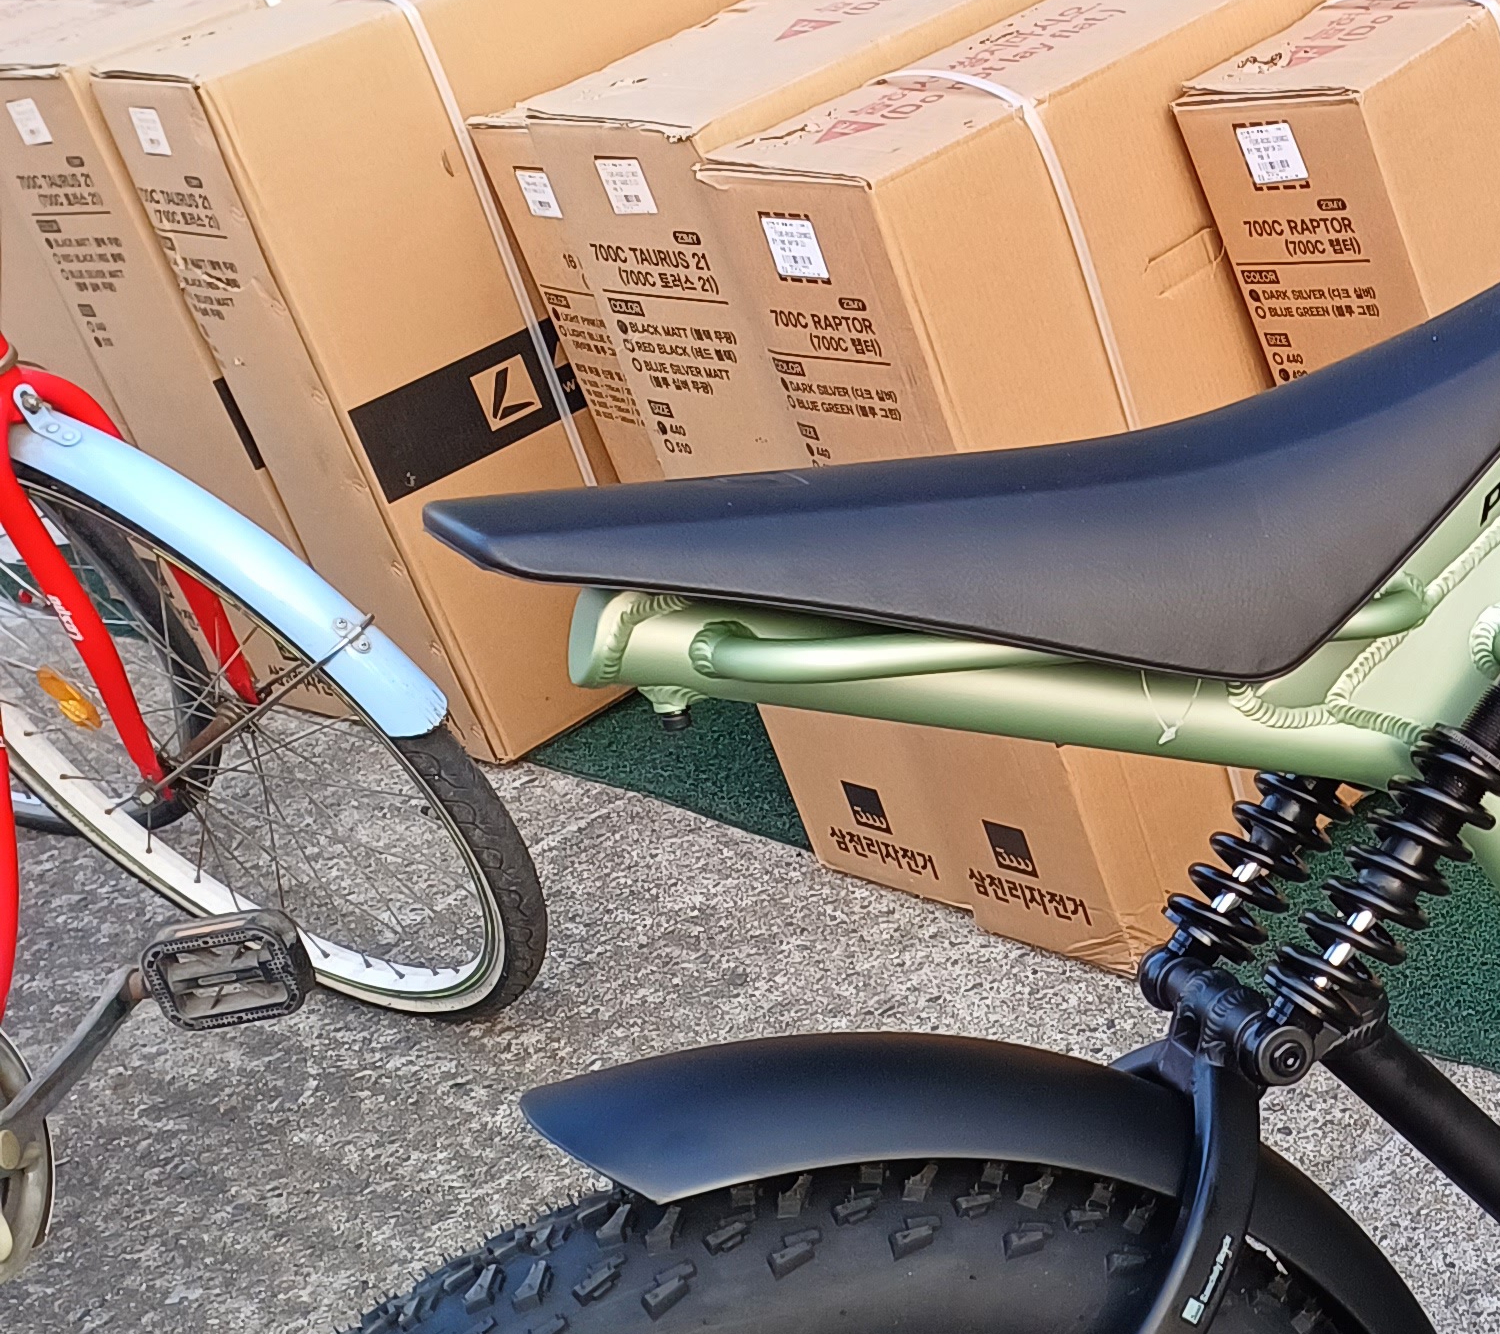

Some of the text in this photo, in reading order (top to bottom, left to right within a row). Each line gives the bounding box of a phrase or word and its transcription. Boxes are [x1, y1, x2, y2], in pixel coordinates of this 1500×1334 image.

[880, 93, 945, 120] (Do
[998, 42, 1055, 63] lay
[1243, 217, 1356, 238] 700C RAPTOR
[1285, 236, 1361, 257] (700C 랩터)
[589, 243, 711, 271] 700C TAURUS 21
[618, 267, 720, 295] (700C 토러스 21)
[1244, 272, 1278, 283] COLOR
[1262, 289, 1291, 301] DARK
[1291, 288, 1327, 301] SILVER
[610, 300, 643, 314] COLOR
[1268, 306, 1295, 317] BLUE
[1296, 305, 1331, 317] GREEN
[629, 321, 661, 336] BLACK
[661, 325, 688, 339] MATT
[770, 309, 876, 335] 700C RAPTOR
[635, 339, 656, 354] RED
[656, 343, 690, 358] BLACK
[810, 333, 883, 357] (700C 랩터)
[1267, 334, 1289, 346] SIZE
[643, 360, 731, 380] BLUE SILVER MATT
[789, 380, 816, 394] DARK
[816, 384, 850, 398] SILVER
[797, 398, 821, 412] BLUE
[821, 402, 854, 415] GREEN
[828, 825, 939, 881] 삼천리자전거
[967, 867, 1093, 927] 삼천리자전거
